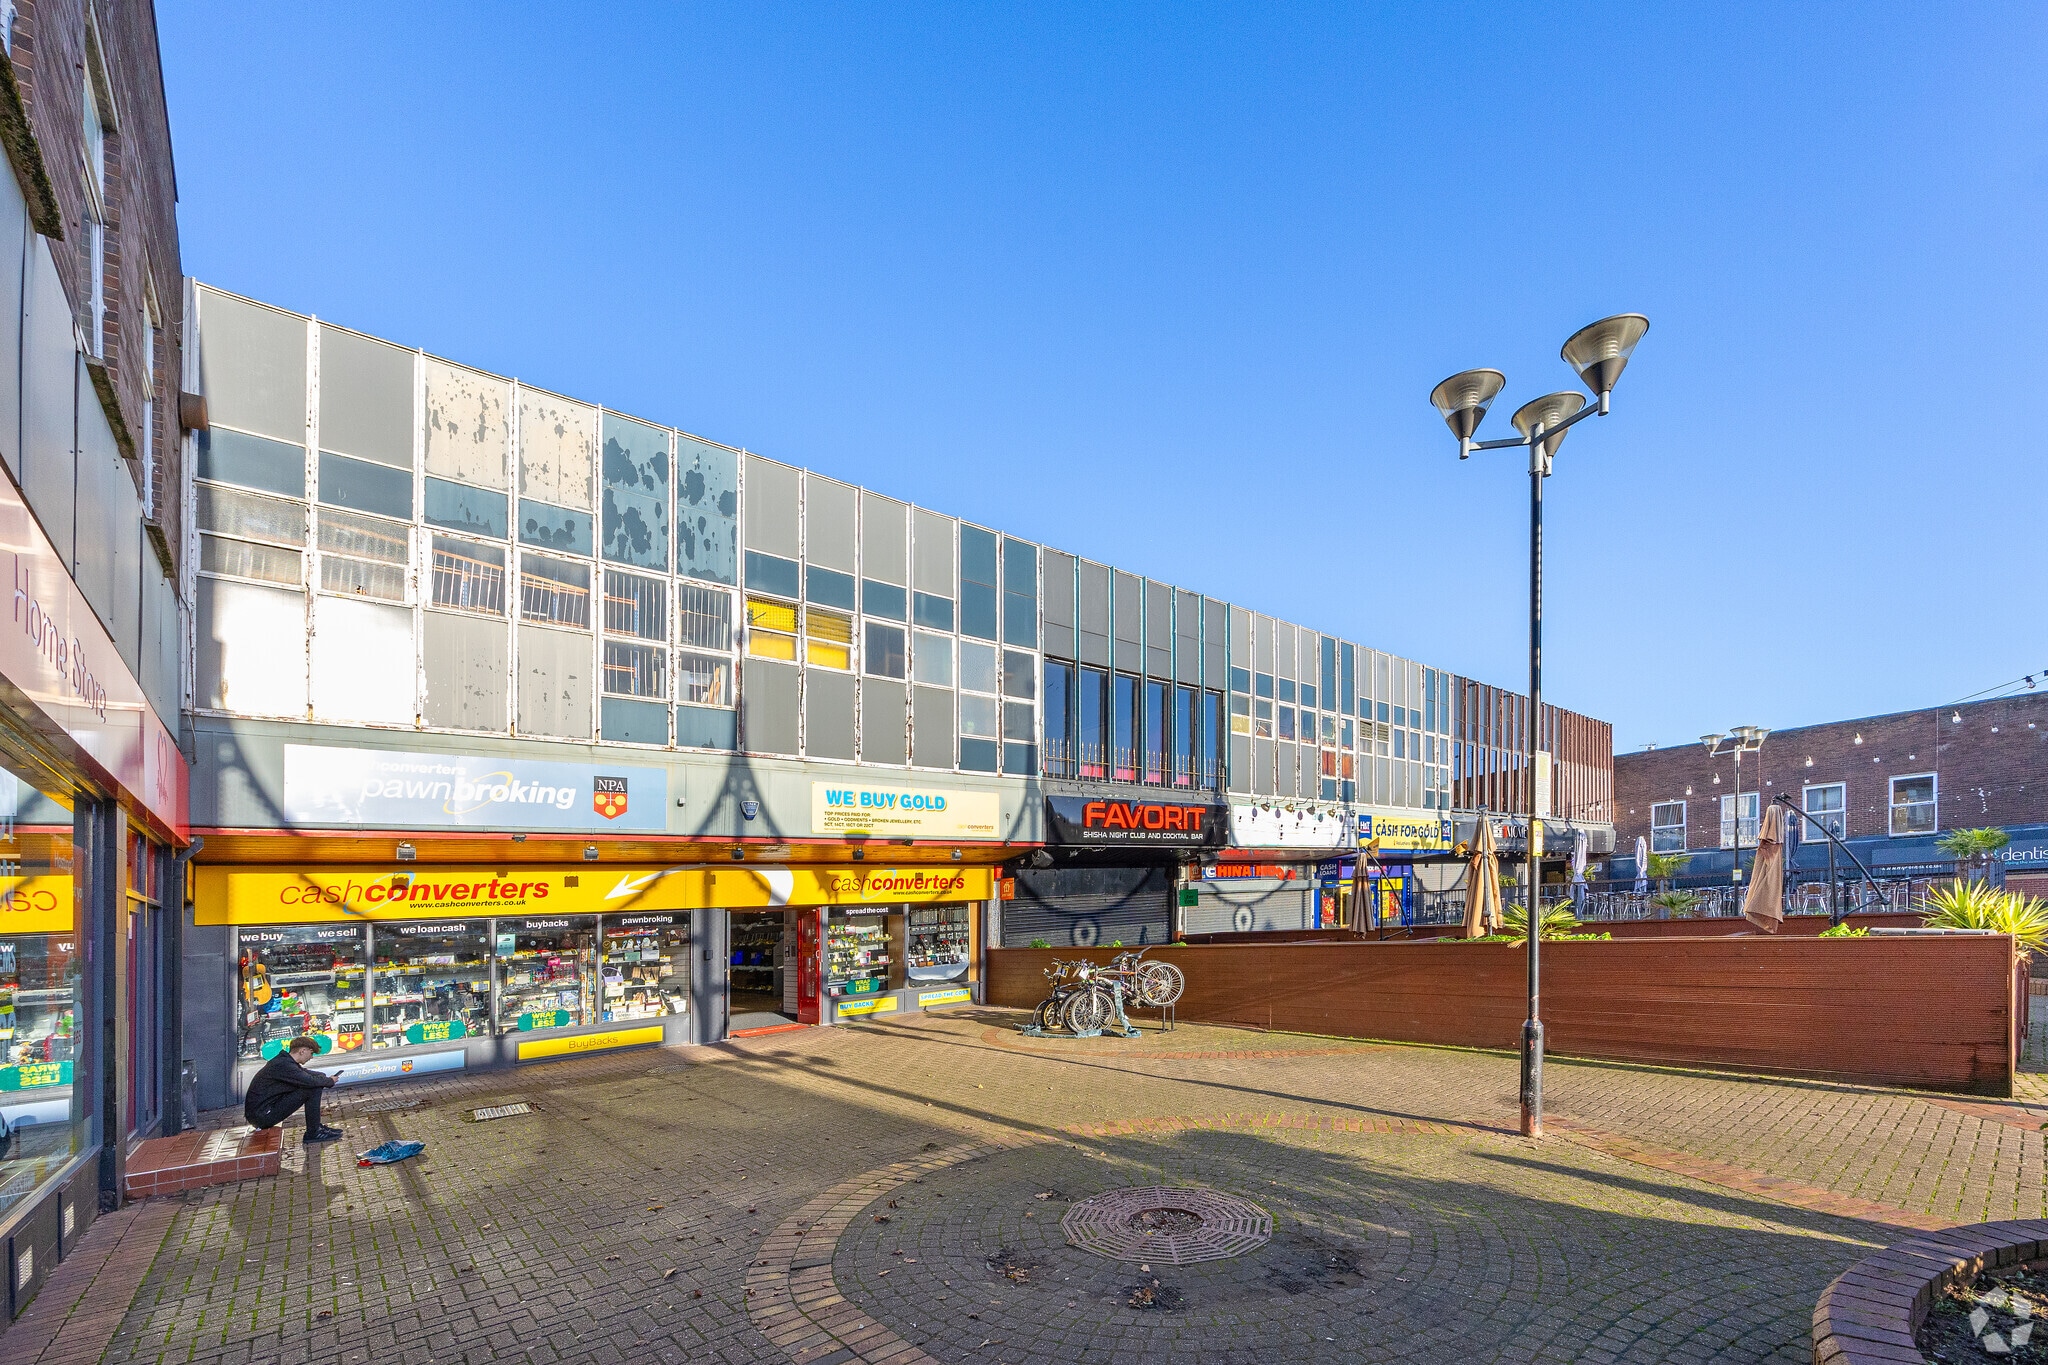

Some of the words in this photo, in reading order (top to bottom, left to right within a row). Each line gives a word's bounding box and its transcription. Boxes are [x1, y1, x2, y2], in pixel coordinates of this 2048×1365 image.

[14, 553, 68, 680] Home
[72, 637, 107, 724] Store
[597, 779, 627, 793] NPA
[360, 775, 577, 810] pawnbroking
[826, 789, 855, 806] WE
[860, 791, 896, 808] BUY
[900, 793, 947, 811] GOLD
[1083, 801, 1206, 831] FAVORIT
[1083, 831, 1107, 839] SHISHA
[1109, 831, 1128, 839] NIGHT
[1162, 832, 1189, 840] COCKTAIL
[1191, 832, 1204, 840] BAR
[1375, 823, 1398, 836] CASH
[1400, 825, 1417, 838] FOR
[1418, 826, 1439, 838] GOLD
[1319, 863, 1337, 871] CASH
[831, 874, 965, 892] cashconverters
[280, 878, 550, 905] cashconverters
[409, 899, 527, 910] www.cashconverters.co.uk
[845, 907, 867, 917] spread
[875, 906, 889, 914] cost
[526, 919, 569, 930] buybacks
[621, 915, 673, 926] pawnbroking
[317, 929, 333, 938] we
[335, 927, 357, 938] sell
[400, 926, 417, 935] we
[417, 924, 441, 934] loan
[441, 923, 466, 933] cash
[240, 933, 260, 942] we
[261, 932, 284, 943] buy
[531, 1011, 557, 1019] WRAP
[341, 1023, 361, 1033] NPA
[423, 1022, 451, 1031] WRAP
[532, 1019, 556, 1028] LESS
[423, 1031, 450, 1040] LESS
[568, 1036, 619, 1050] BuyBacks
[341, 1064, 397, 1078] awnbroking
